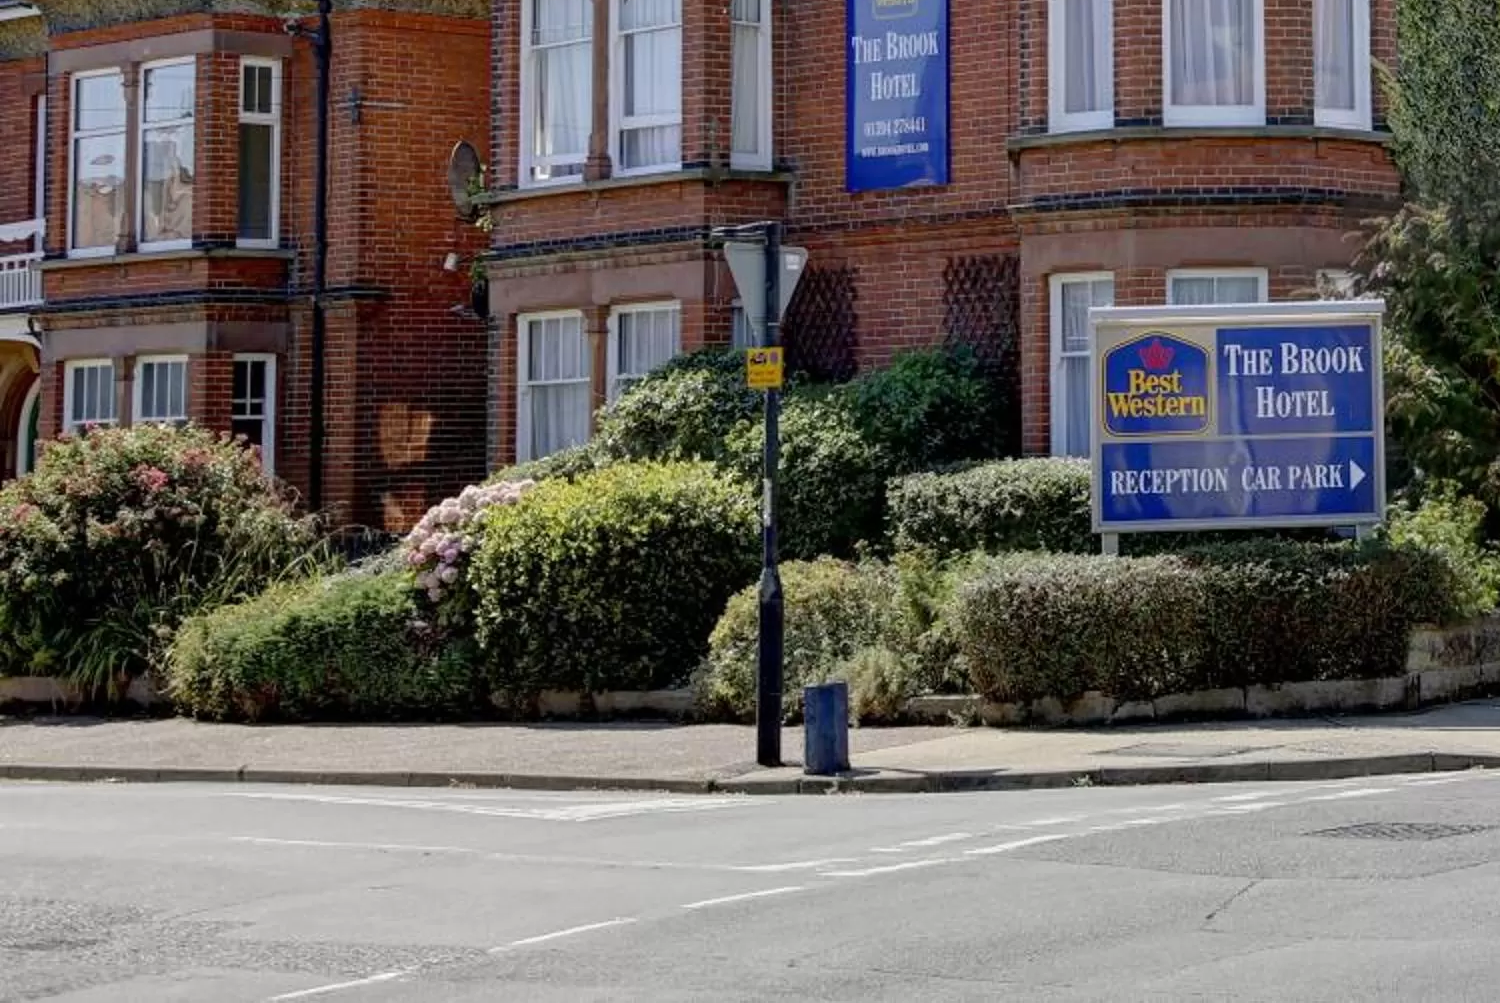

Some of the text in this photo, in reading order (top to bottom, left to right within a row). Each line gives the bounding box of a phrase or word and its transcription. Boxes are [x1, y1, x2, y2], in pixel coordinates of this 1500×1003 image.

[852, 32, 939, 64] THE BROOK
[870, 72, 920, 101] HOTEL
[1223, 342, 1364, 376] THE BROOK
[1128, 369, 1183, 394] Best
[1108, 392, 1205, 418] Western
[1256, 386, 1335, 418] HOTEL
[1110, 464, 1344, 495] RECEPTION CAR PARK
